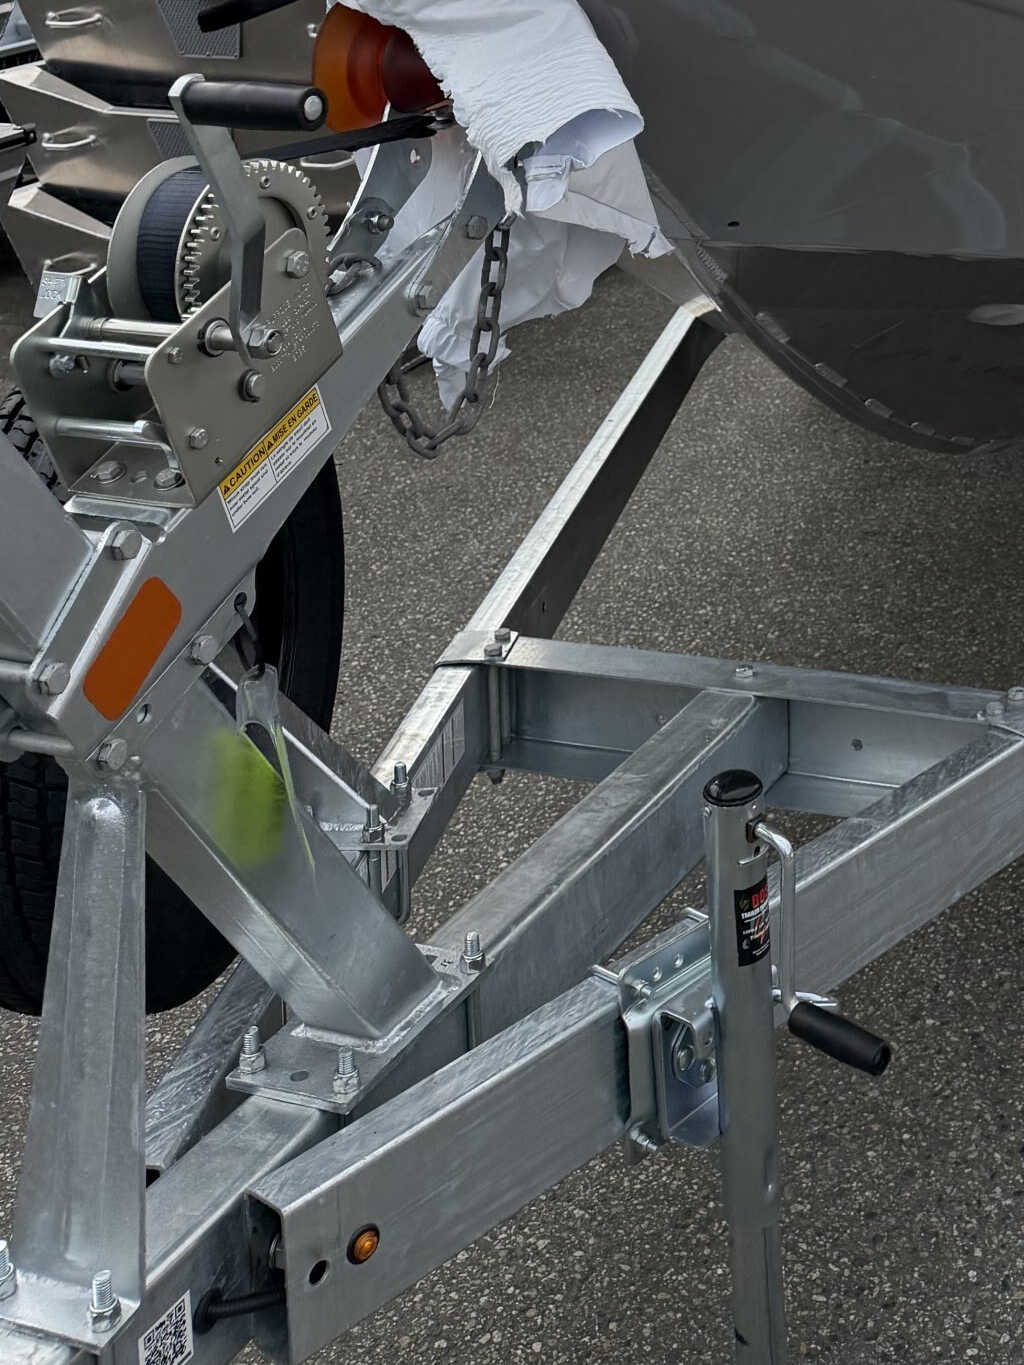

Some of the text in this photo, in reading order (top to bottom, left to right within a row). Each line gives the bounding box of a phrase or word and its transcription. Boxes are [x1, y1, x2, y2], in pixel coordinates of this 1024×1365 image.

[272, 425, 288, 443] MISE
[287, 416, 297, 428] EN
[296, 393, 318, 418] GARDE
[229, 446, 265, 487] CAUTION
